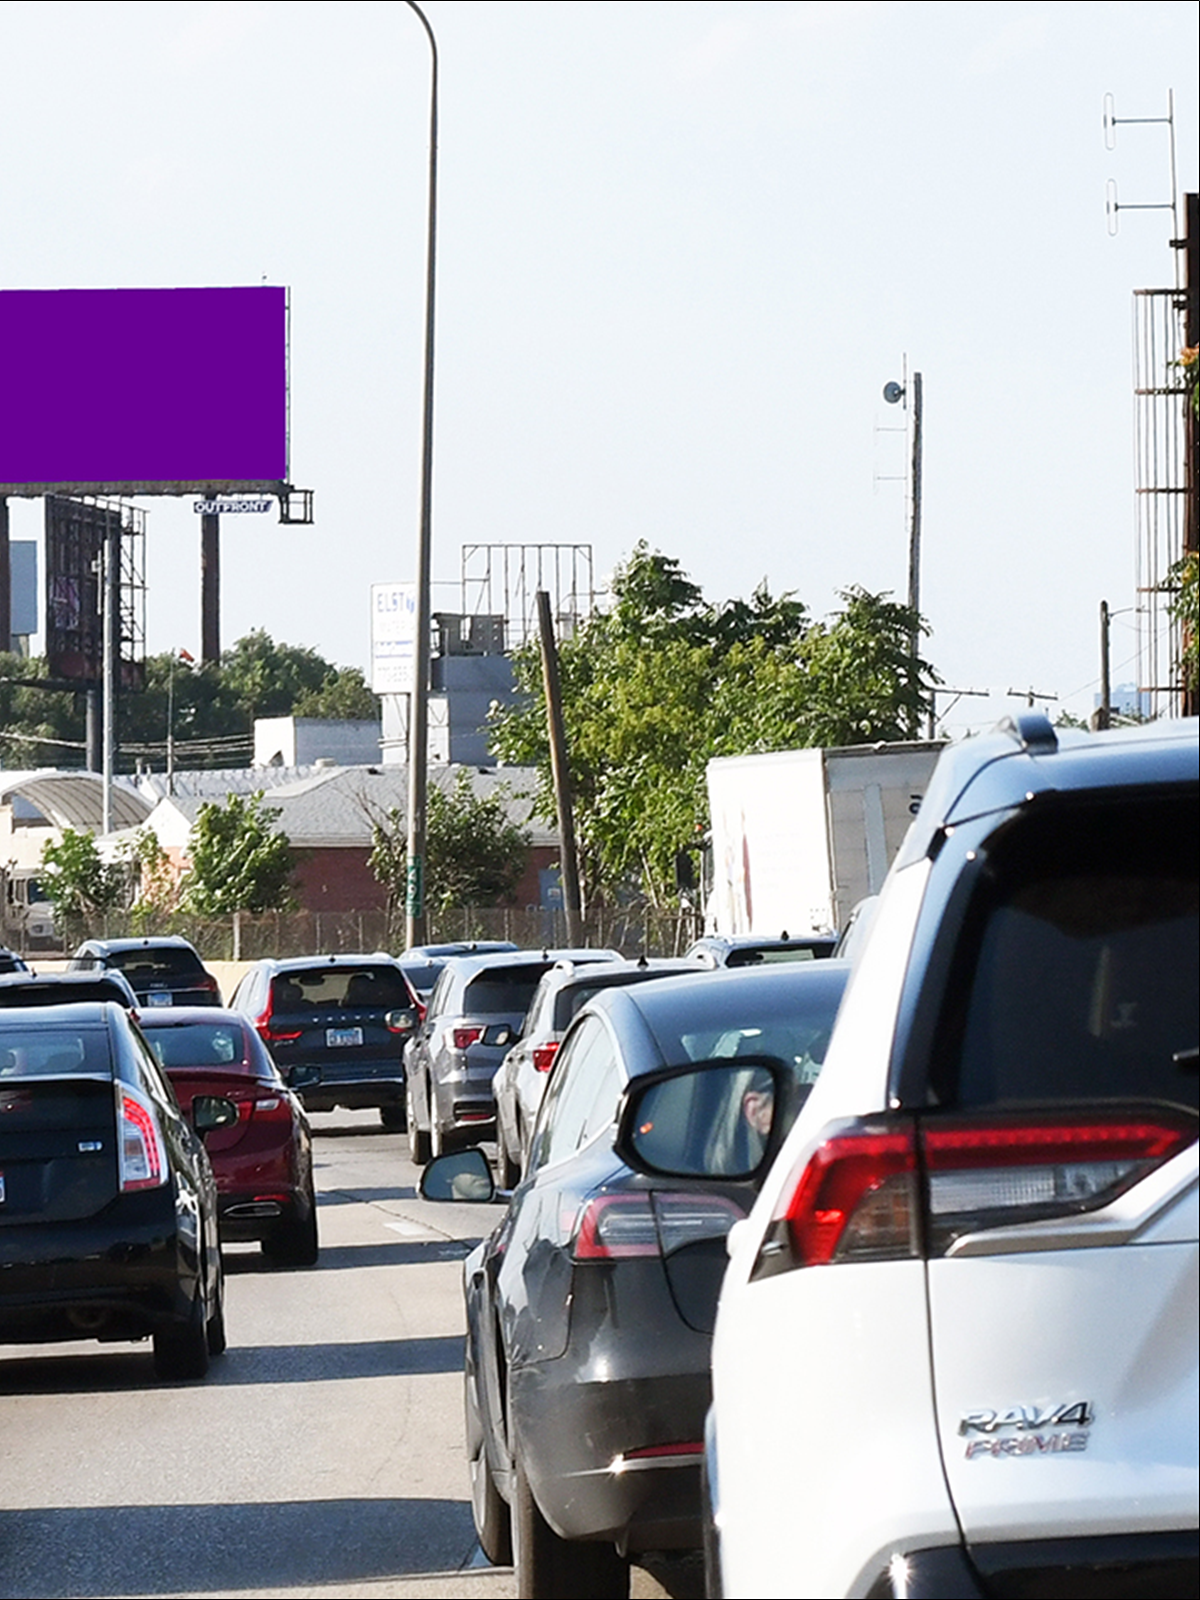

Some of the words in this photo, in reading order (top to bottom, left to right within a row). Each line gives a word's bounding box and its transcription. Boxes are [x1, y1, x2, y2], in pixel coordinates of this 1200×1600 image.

[195, 502, 266, 514] OUTFRONT
[958, 1401, 1093, 1436] RAV4
[965, 1431, 1090, 1460] PRIME
